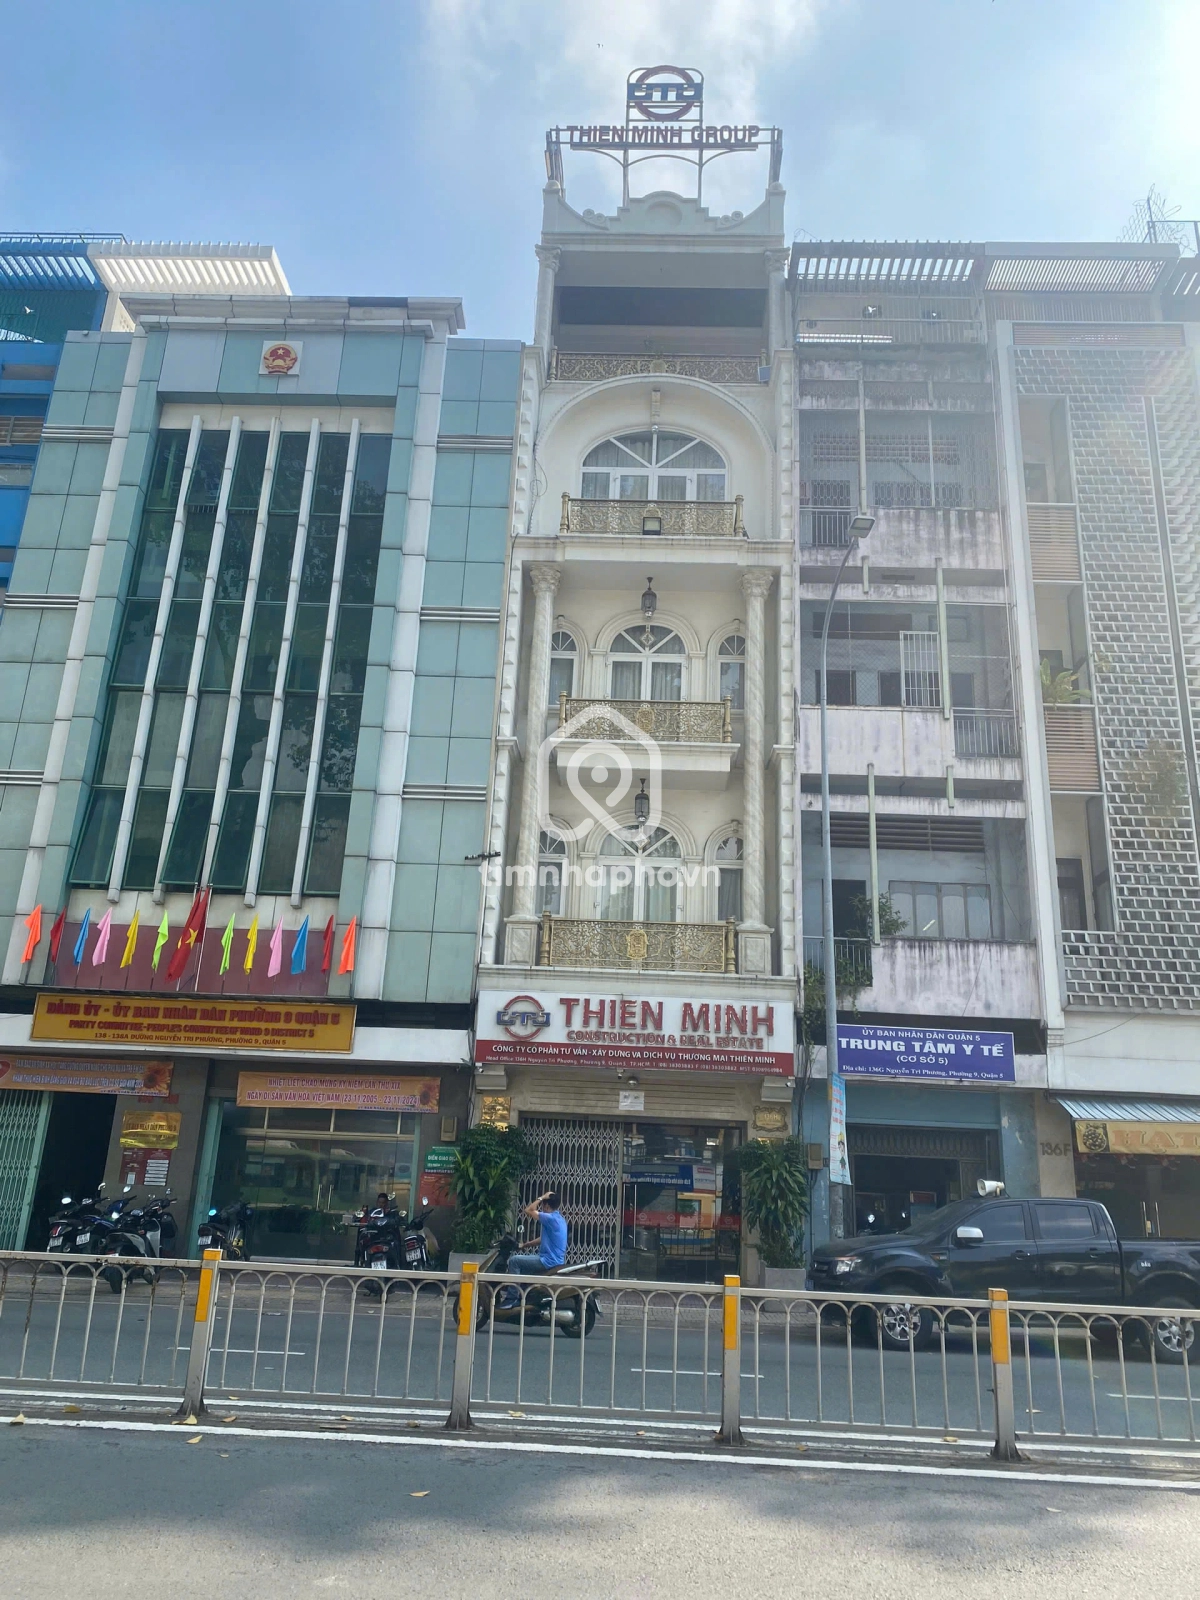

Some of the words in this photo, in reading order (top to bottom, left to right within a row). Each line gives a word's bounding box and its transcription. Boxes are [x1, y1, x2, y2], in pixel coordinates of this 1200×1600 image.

[567, 125, 624, 143] THIEN
[632, 125, 682, 143] MINH
[691, 125, 760, 143] GROUP
[132, 1006, 160, 1018] BAN
[162, 1005, 198, 1020] NHÂN
[199, 1006, 227, 1021] DÂN
[283, 1011, 293, 1024] 9
[331, 1013, 340, 1025] 5
[560, 998, 663, 1031] THIEN
[681, 1002, 774, 1036] MINH
[69, 1020, 97, 1029] PARTY
[240, 1027, 262, 1036] WARD
[264, 1028, 270, 1036] 9
[271, 1028, 308, 1037] DISTRICT
[308, 1029, 315, 1038] 5
[862, 1027, 874, 1036] ỦY
[926, 1032, 944, 1040] DÂN
[947, 1033, 973, 1042] QUẬN
[566, 1030, 665, 1046] CONSTRUCTION
[667, 1034, 677, 1046] &
[680, 1034, 713, 1048] REAL
[715, 1035, 764, 1050] ESTATE
[838, 1038, 905, 1052] TRUNG
[911, 1040, 955, 1055] TÂM
[962, 1044, 974, 1055] Y
[980, 1043, 1005, 1057] TẾ
[755, 1056, 776, 1064] MINH
[896, 1055, 917, 1063] (CƠ
[920, 1054, 935, 1064] SỞ
[938, 1057, 948, 1066] 5)
[1040, 1142, 1071, 1156] 136F
